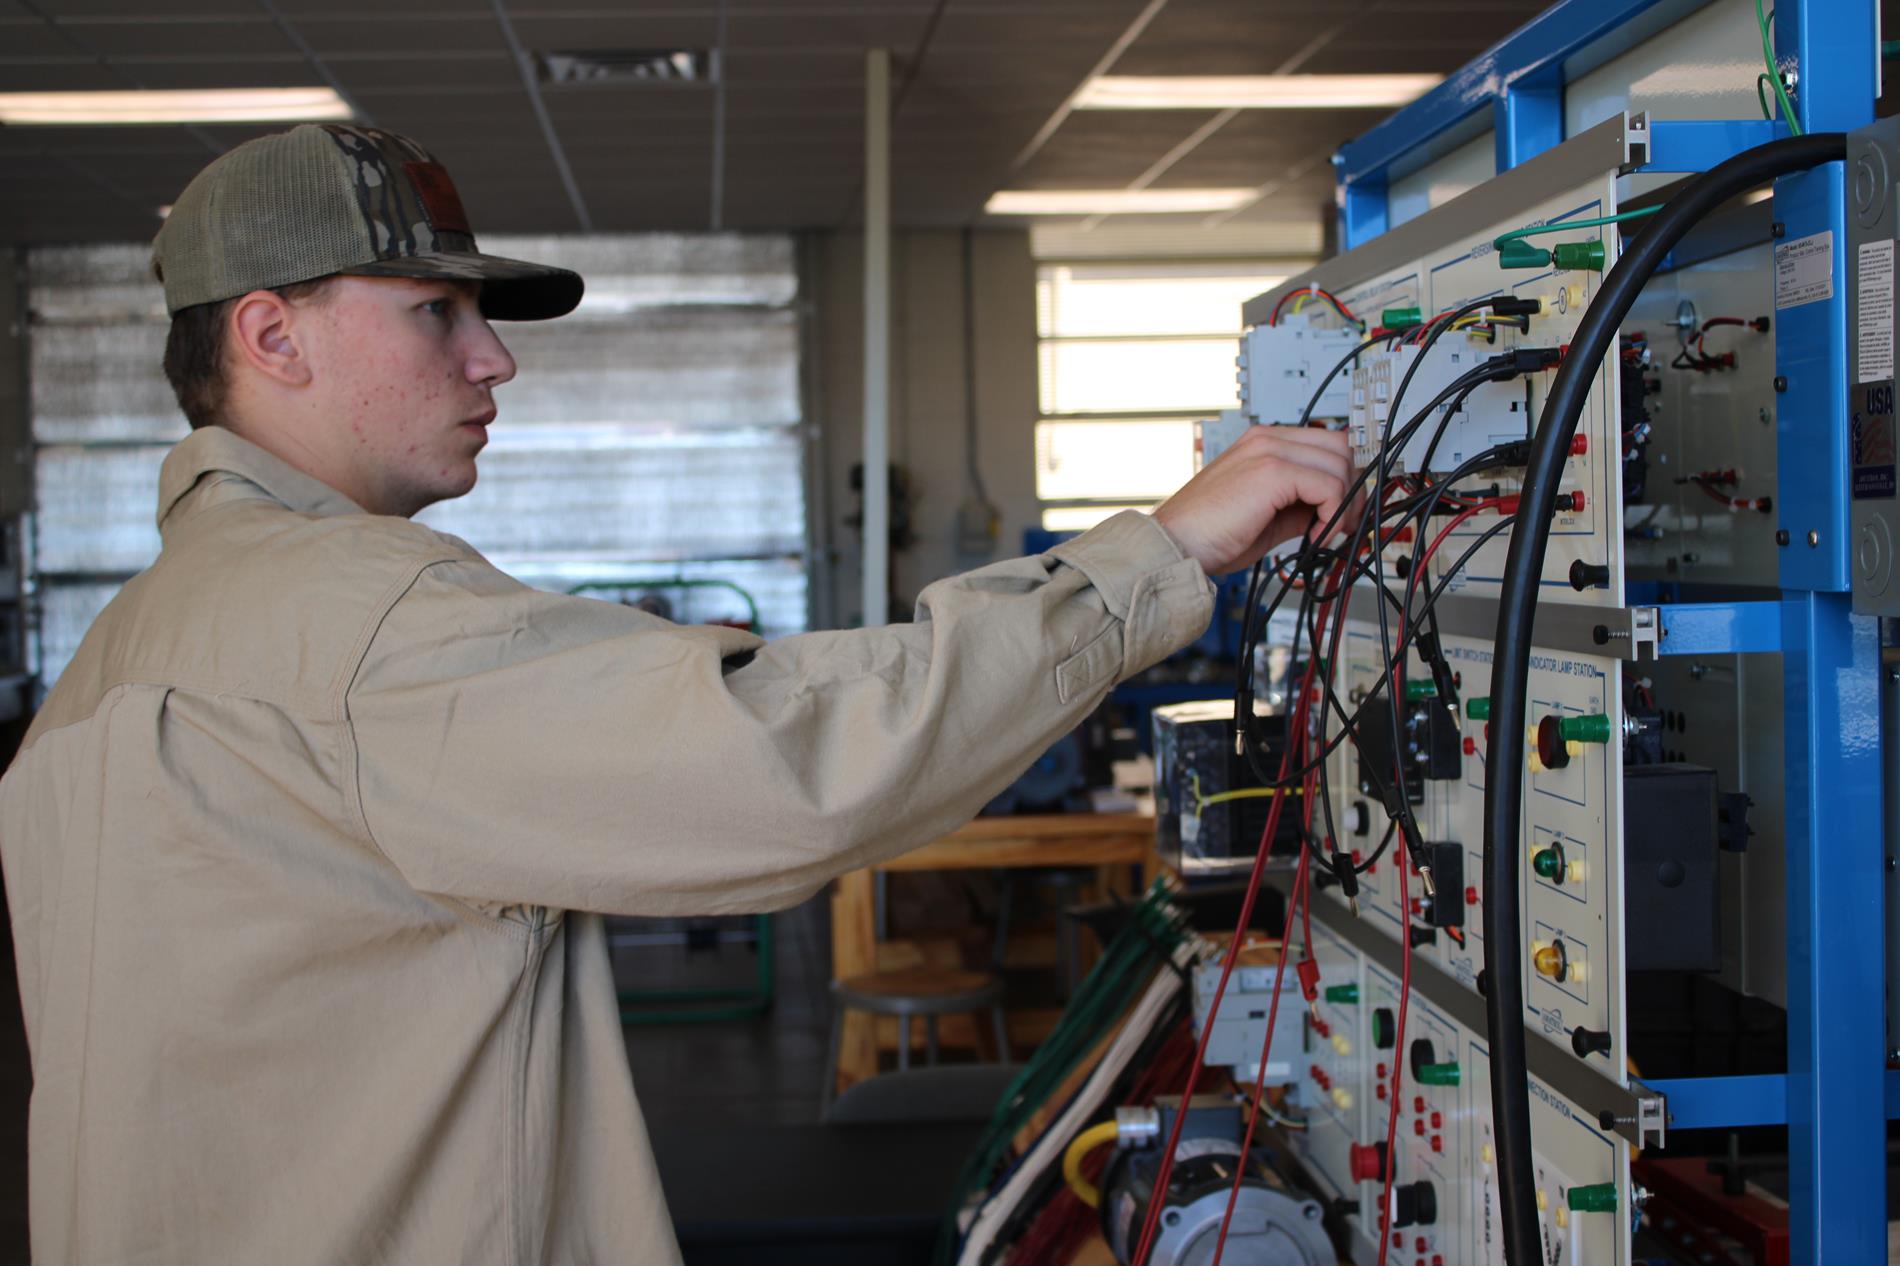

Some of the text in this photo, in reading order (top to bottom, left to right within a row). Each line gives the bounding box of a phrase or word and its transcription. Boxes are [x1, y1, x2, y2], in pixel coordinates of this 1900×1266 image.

[1866, 385, 1894, 416] USA
[1557, 659, 1572, 674] LAMP
[1573, 662, 1597, 678] STATION
[1550, 1095, 1571, 1119] STATION
